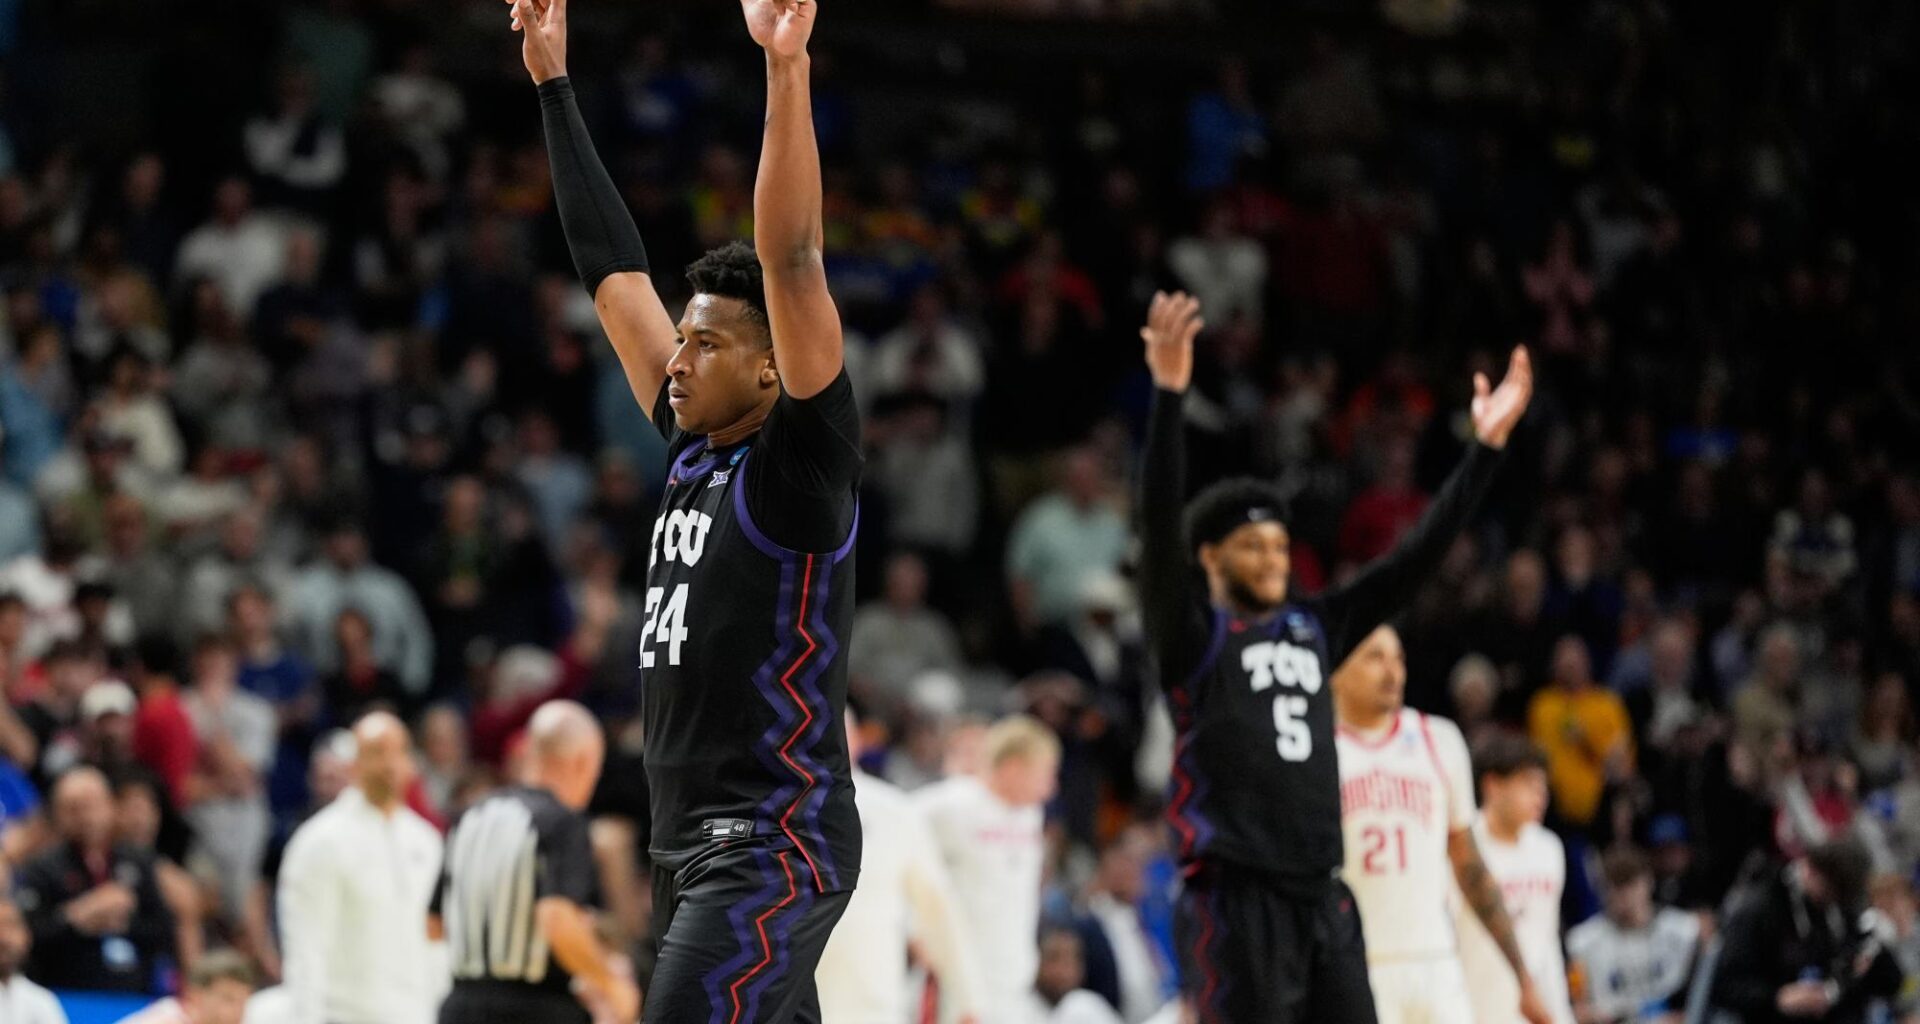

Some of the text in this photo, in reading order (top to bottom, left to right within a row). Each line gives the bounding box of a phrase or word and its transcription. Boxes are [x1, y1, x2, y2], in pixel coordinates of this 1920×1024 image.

[639, 583, 689, 669] 24
[1241, 641, 1322, 694] TCU
[1273, 694, 1312, 762] 5
[733, 823, 745, 831] 48
[1362, 825, 1408, 875] 21
